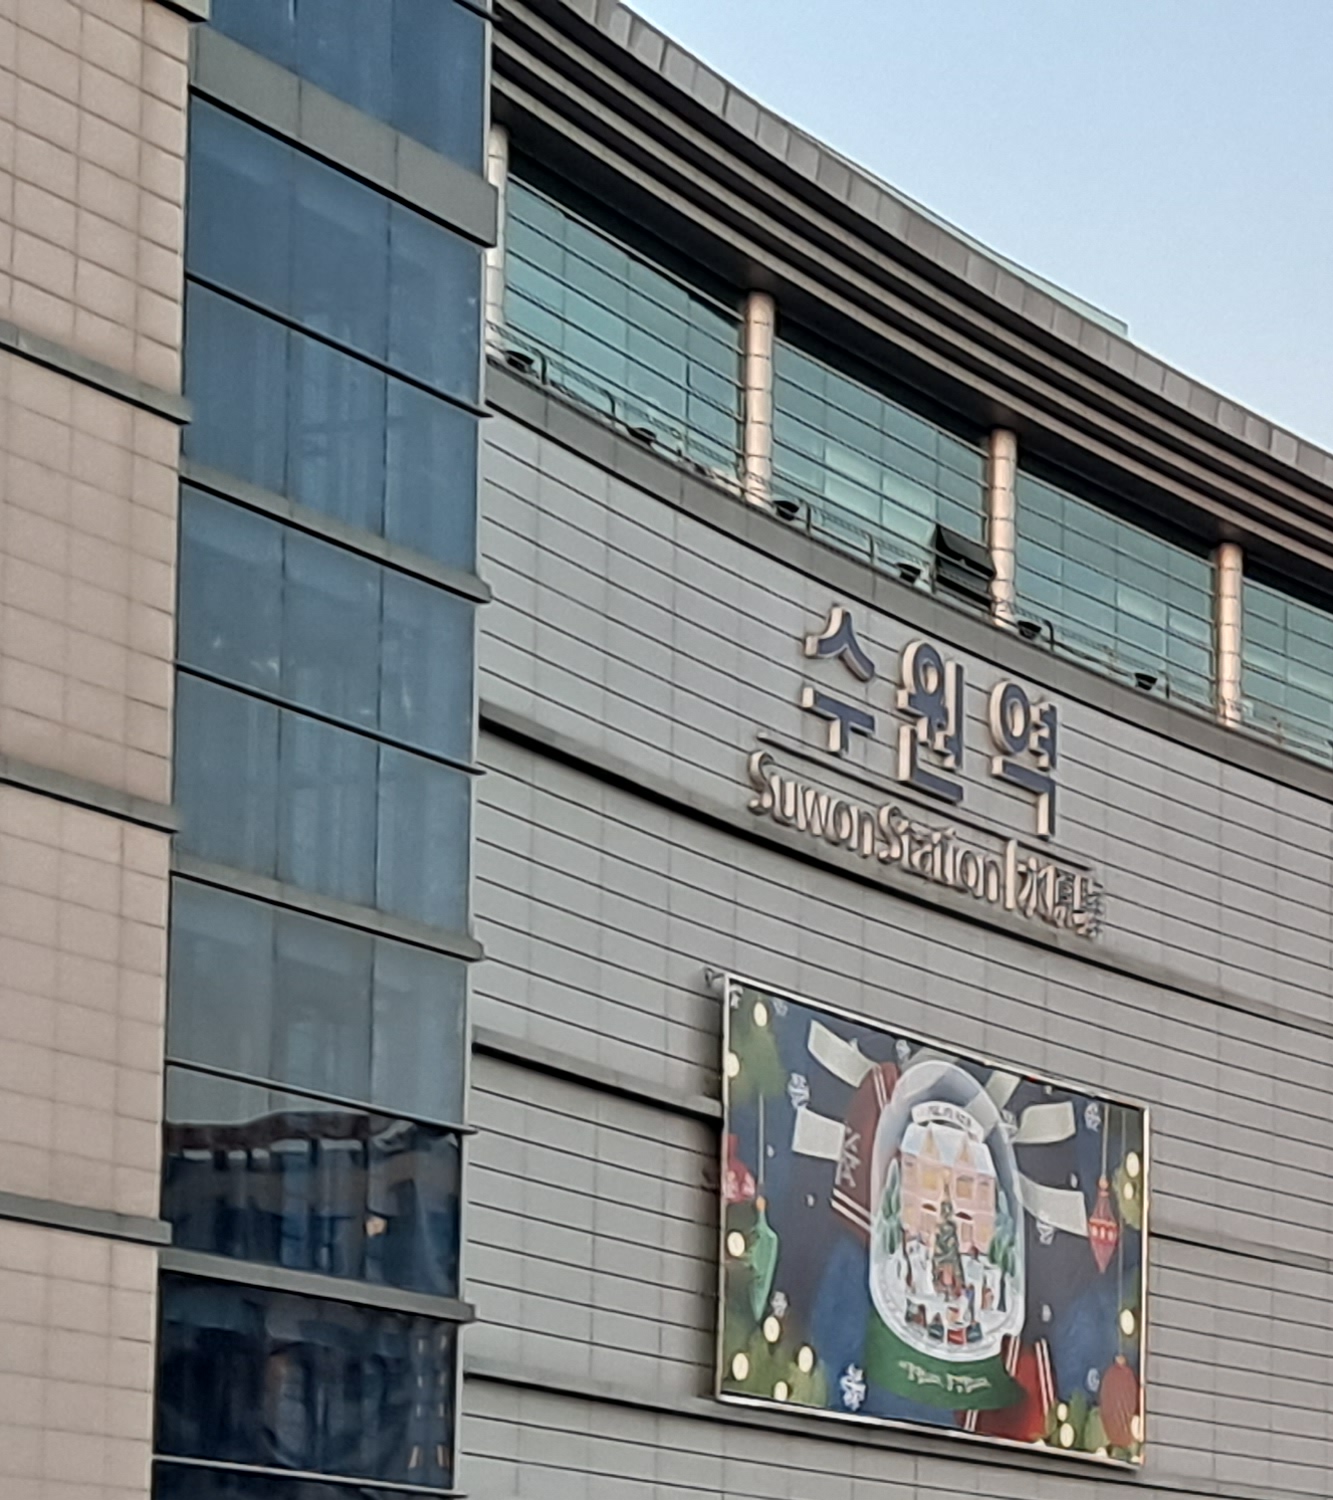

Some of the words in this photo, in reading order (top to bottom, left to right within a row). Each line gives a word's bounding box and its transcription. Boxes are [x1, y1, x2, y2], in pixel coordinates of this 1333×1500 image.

[802, 605, 1058, 841] 수원역
[748, 751, 876, 859] Suwon
[878, 804, 1000, 904] Station
